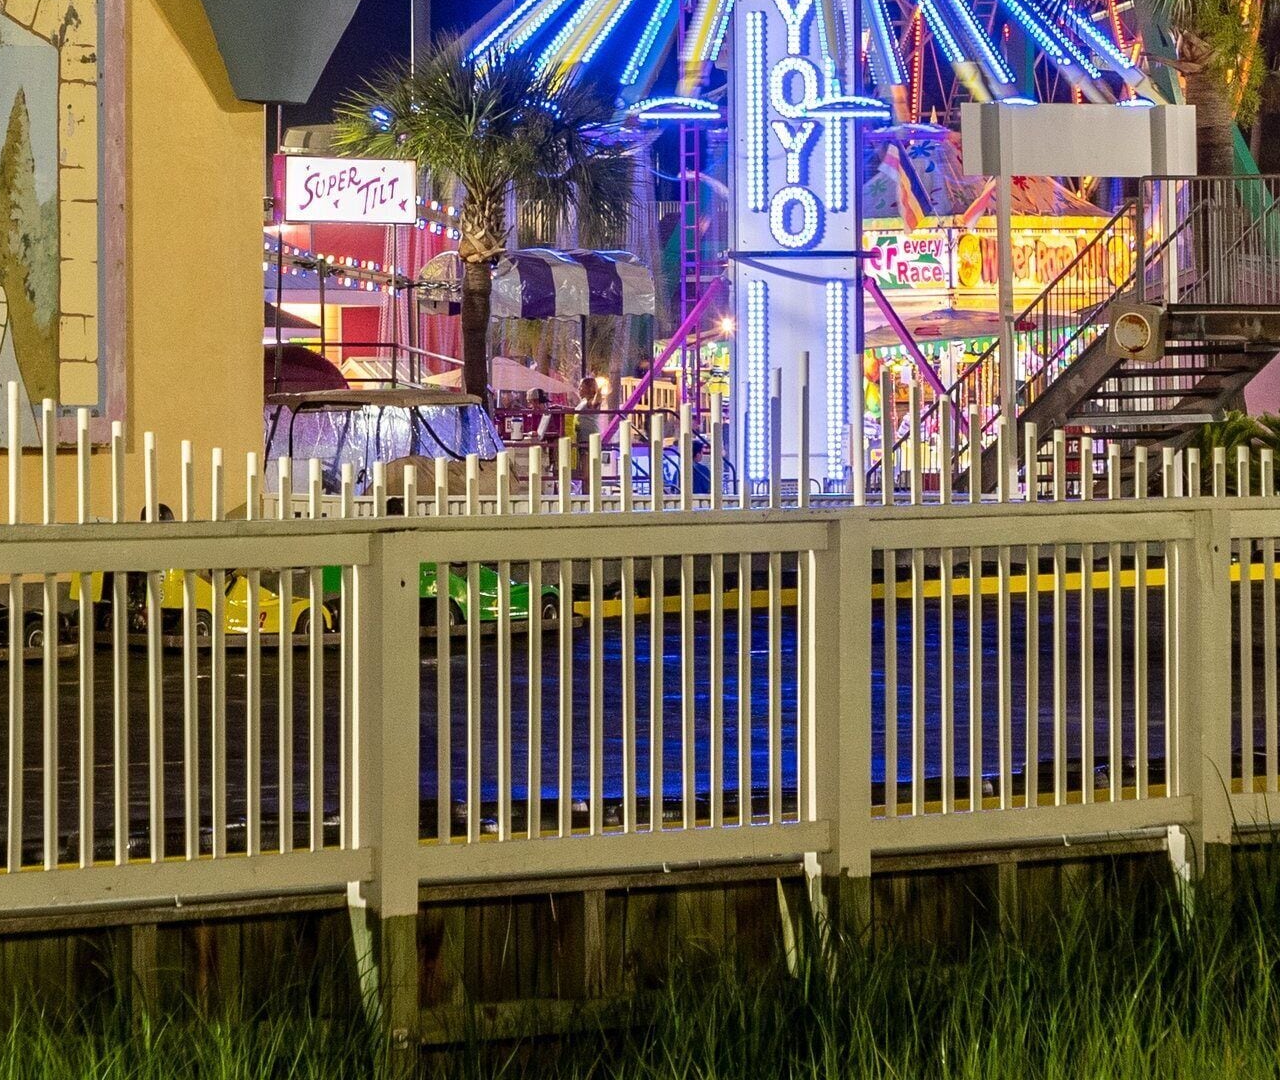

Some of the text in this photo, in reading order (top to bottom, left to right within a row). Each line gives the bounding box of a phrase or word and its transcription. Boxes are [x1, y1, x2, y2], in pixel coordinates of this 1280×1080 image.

[299, 166, 362, 211] SUPER
[357, 177, 399, 215] TILT
[903, 238, 942, 258] every
[897, 261, 944, 282] Race
